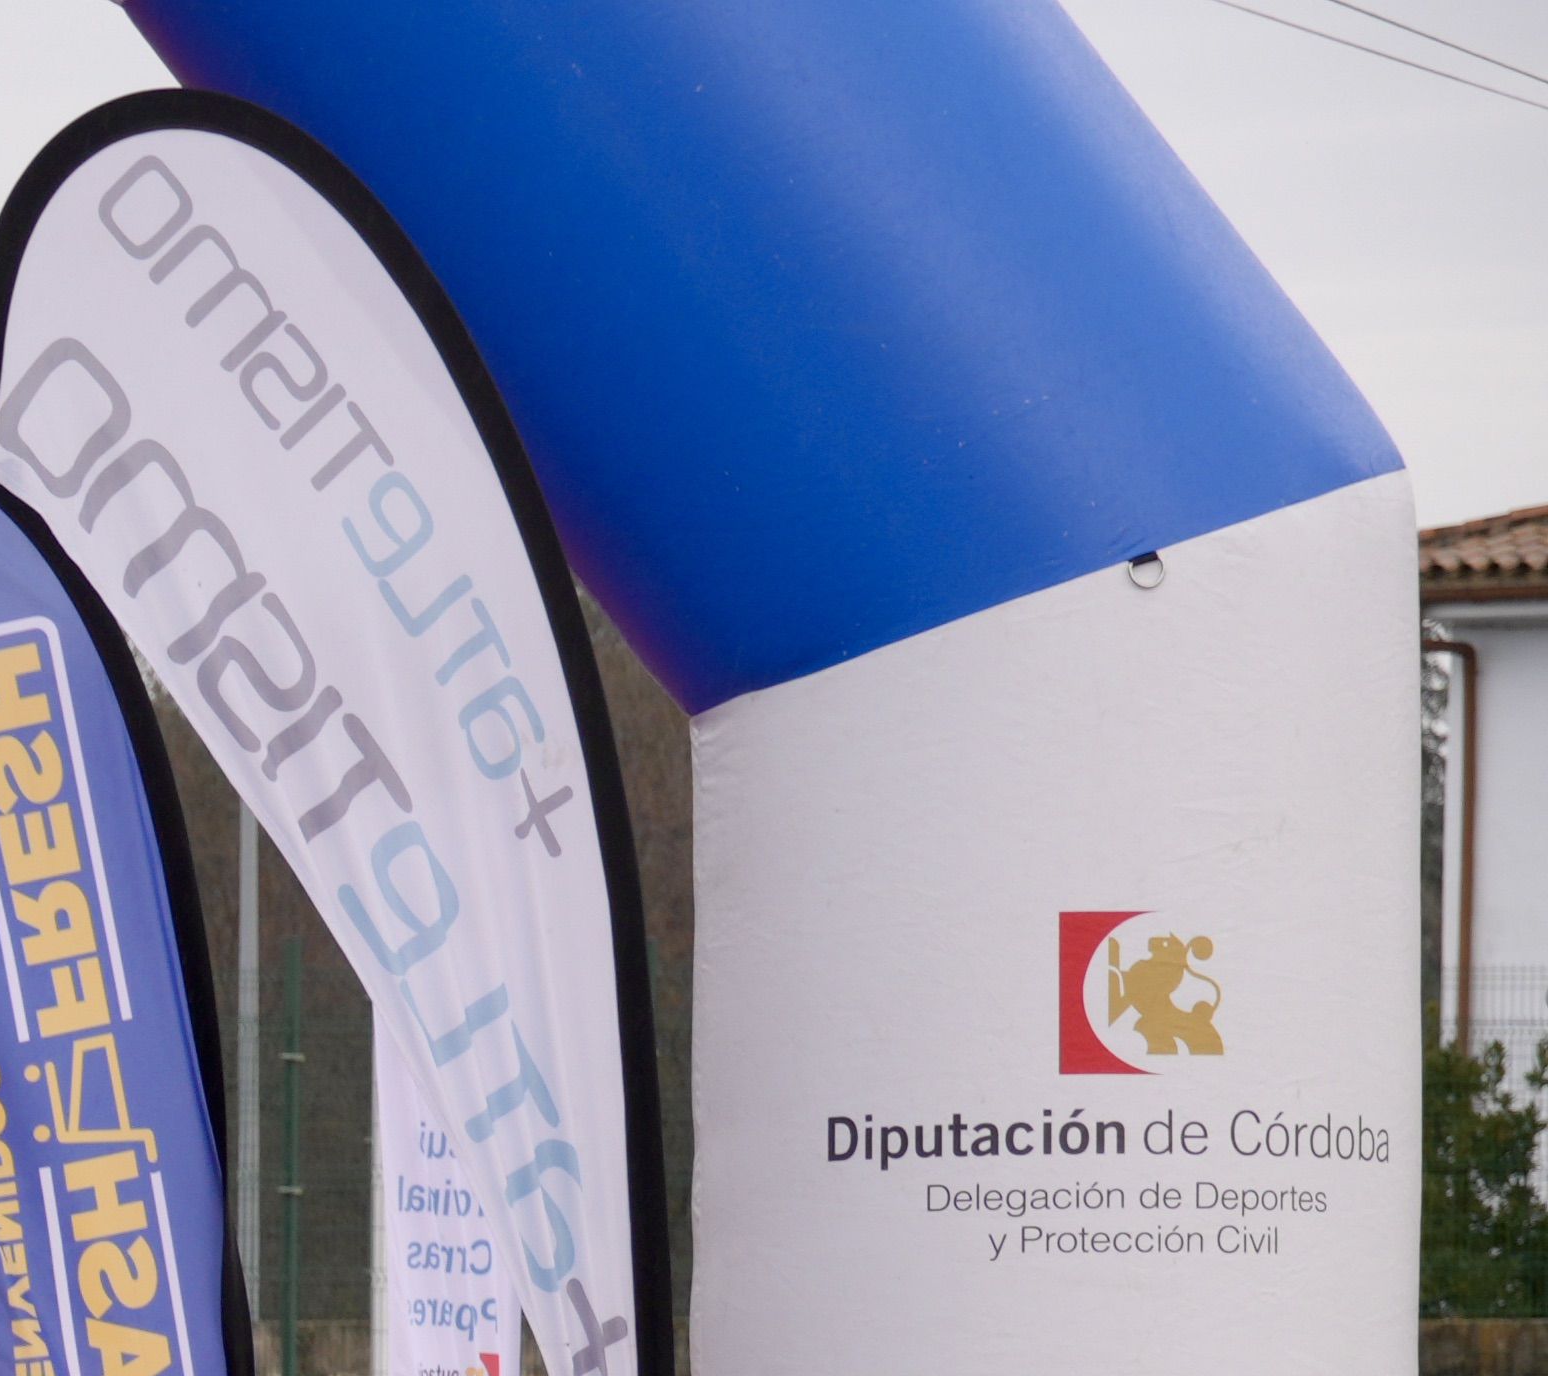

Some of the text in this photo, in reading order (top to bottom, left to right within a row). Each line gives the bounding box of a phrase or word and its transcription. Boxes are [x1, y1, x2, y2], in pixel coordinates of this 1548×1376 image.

[826, 1108, 1392, 1172] Diputación de Córdoba
[925, 1181, 1328, 1218] Delegación de Deportes
[988, 1224, 1280, 1262] y Protección Civil
